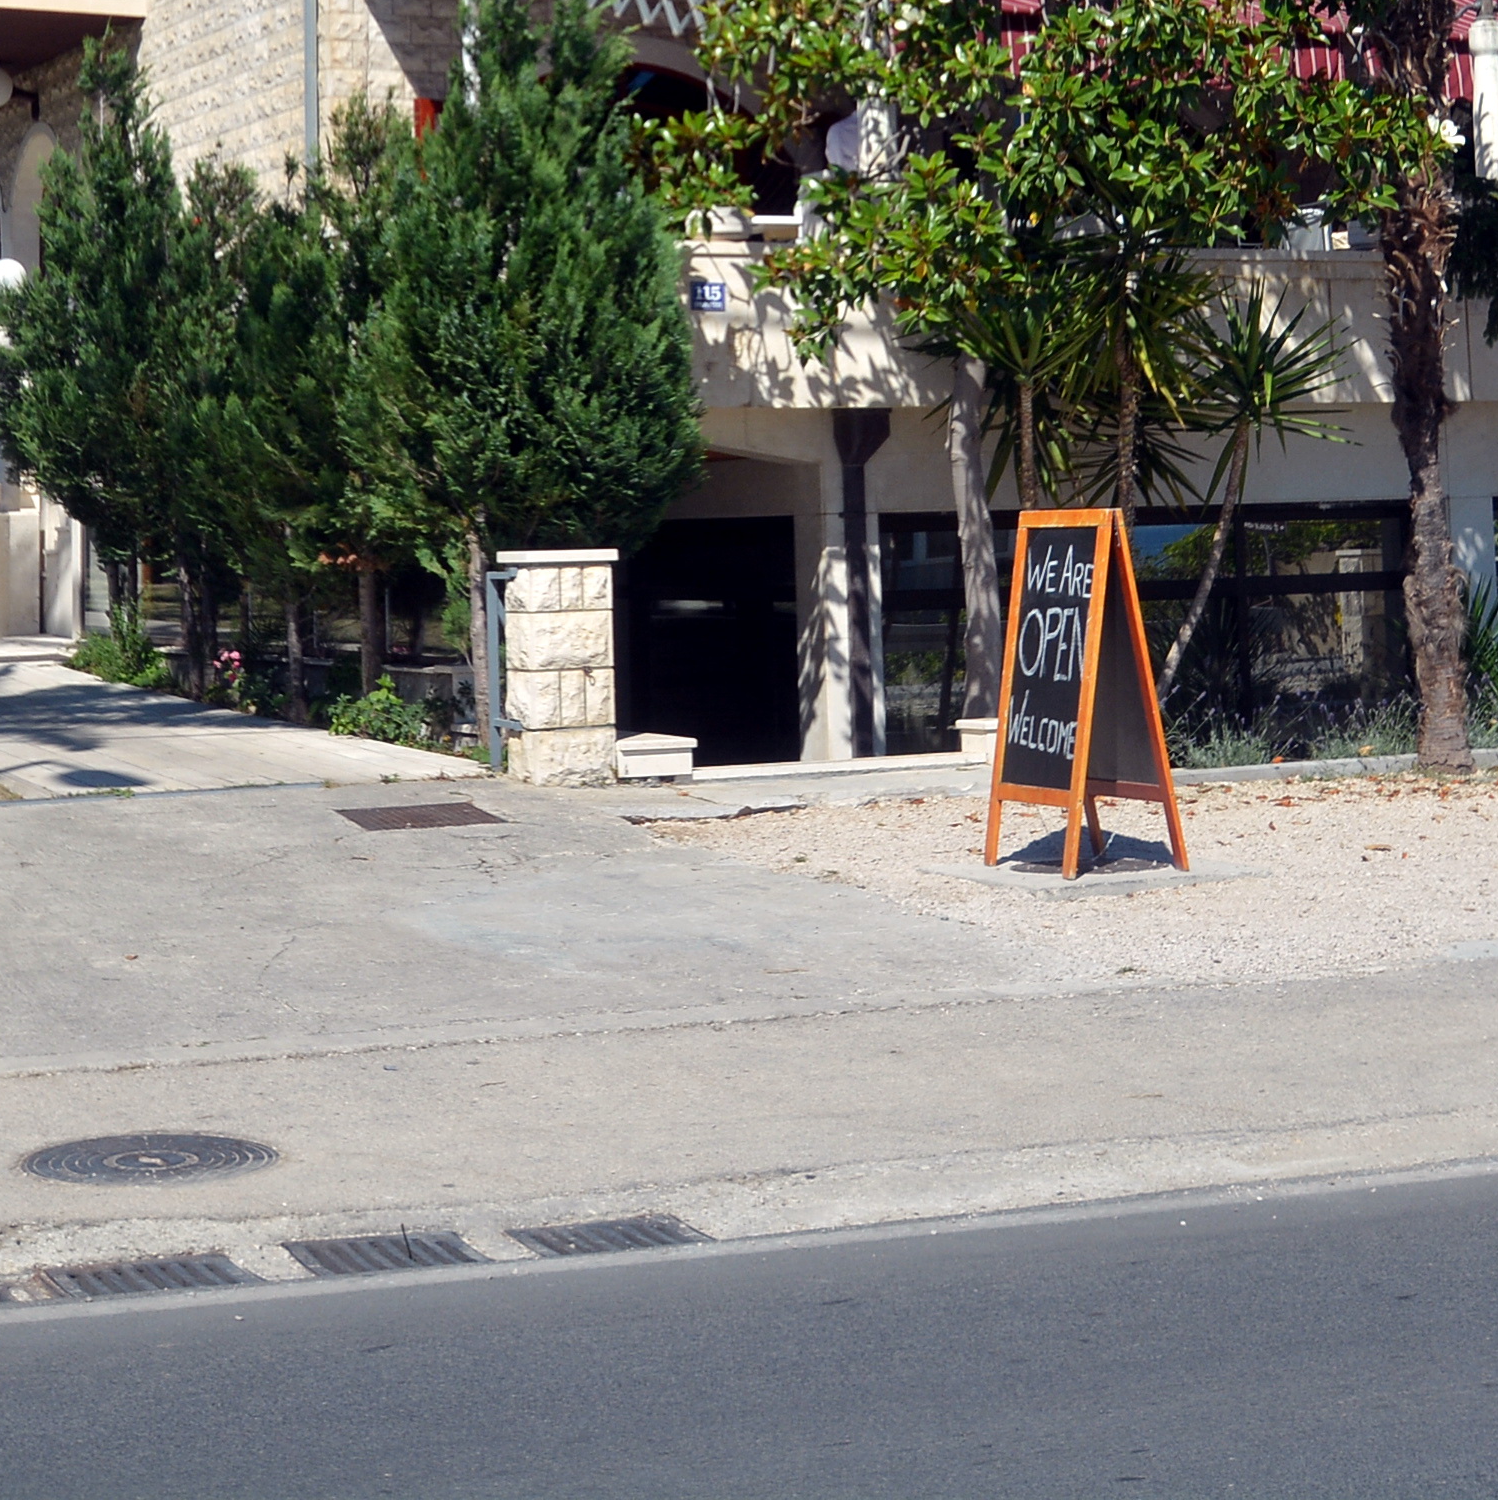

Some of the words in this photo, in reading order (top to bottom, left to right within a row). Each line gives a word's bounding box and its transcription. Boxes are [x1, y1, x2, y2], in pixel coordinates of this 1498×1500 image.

[695, 285, 722, 301] 115
[1027, 544, 1058, 593] WE
[1059, 544, 1095, 598] ARE
[1019, 606, 1085, 682] OPEN
[1007, 689, 1078, 760] WELCOME
